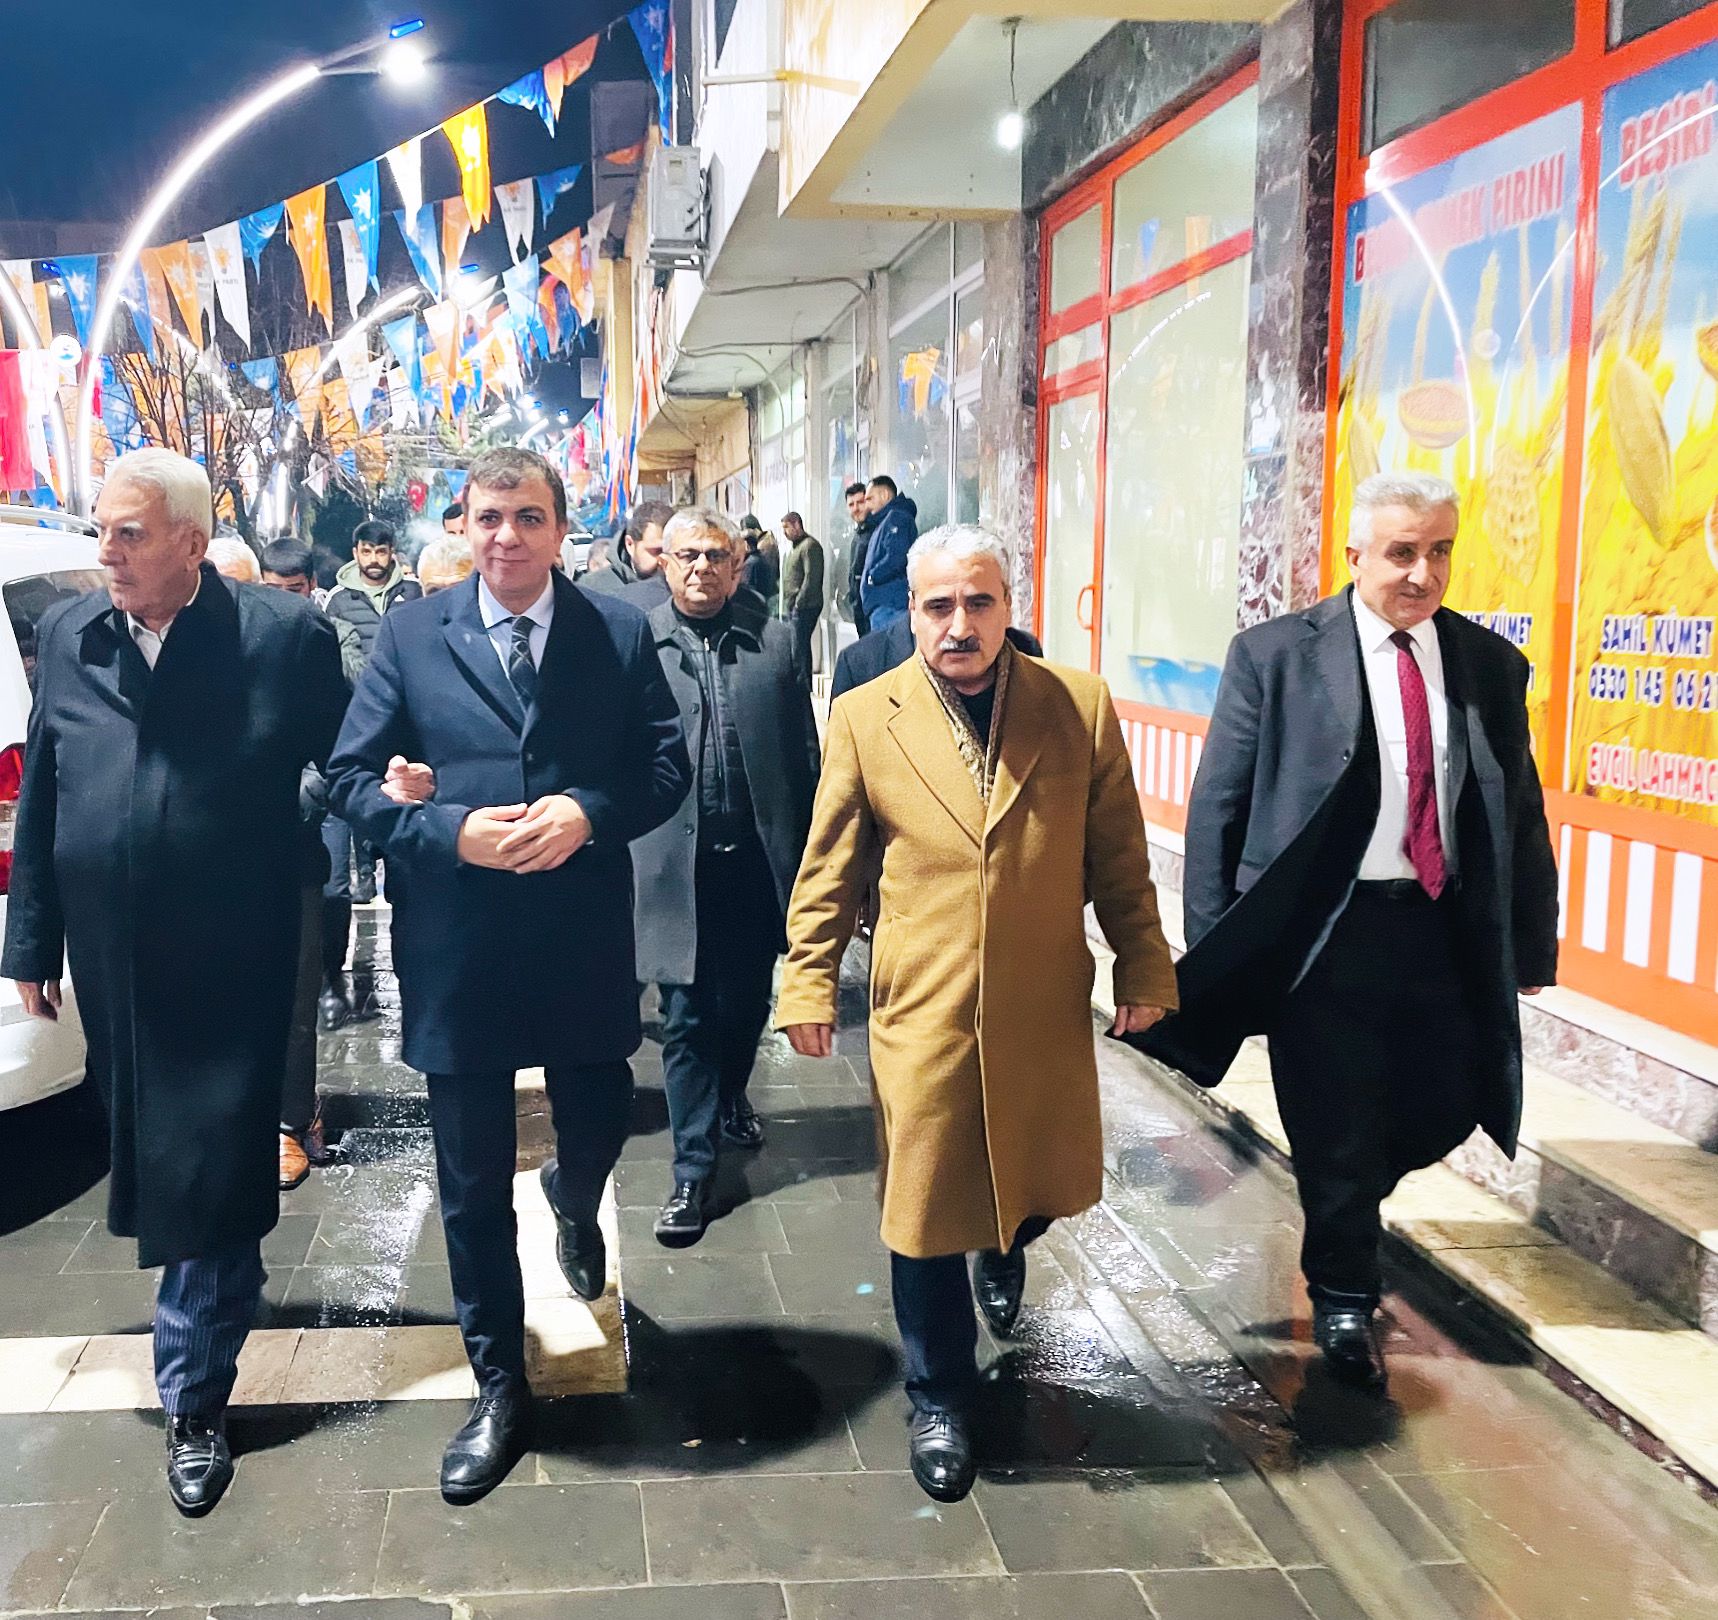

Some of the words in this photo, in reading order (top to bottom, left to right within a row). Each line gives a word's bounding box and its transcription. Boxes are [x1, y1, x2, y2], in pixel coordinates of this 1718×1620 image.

[1491, 152, 1565, 232] FIRINI
[1601, 614, 1646, 652] SAHİL
[1590, 667, 1626, 700] 0530
[1635, 669, 1662, 703] 145
